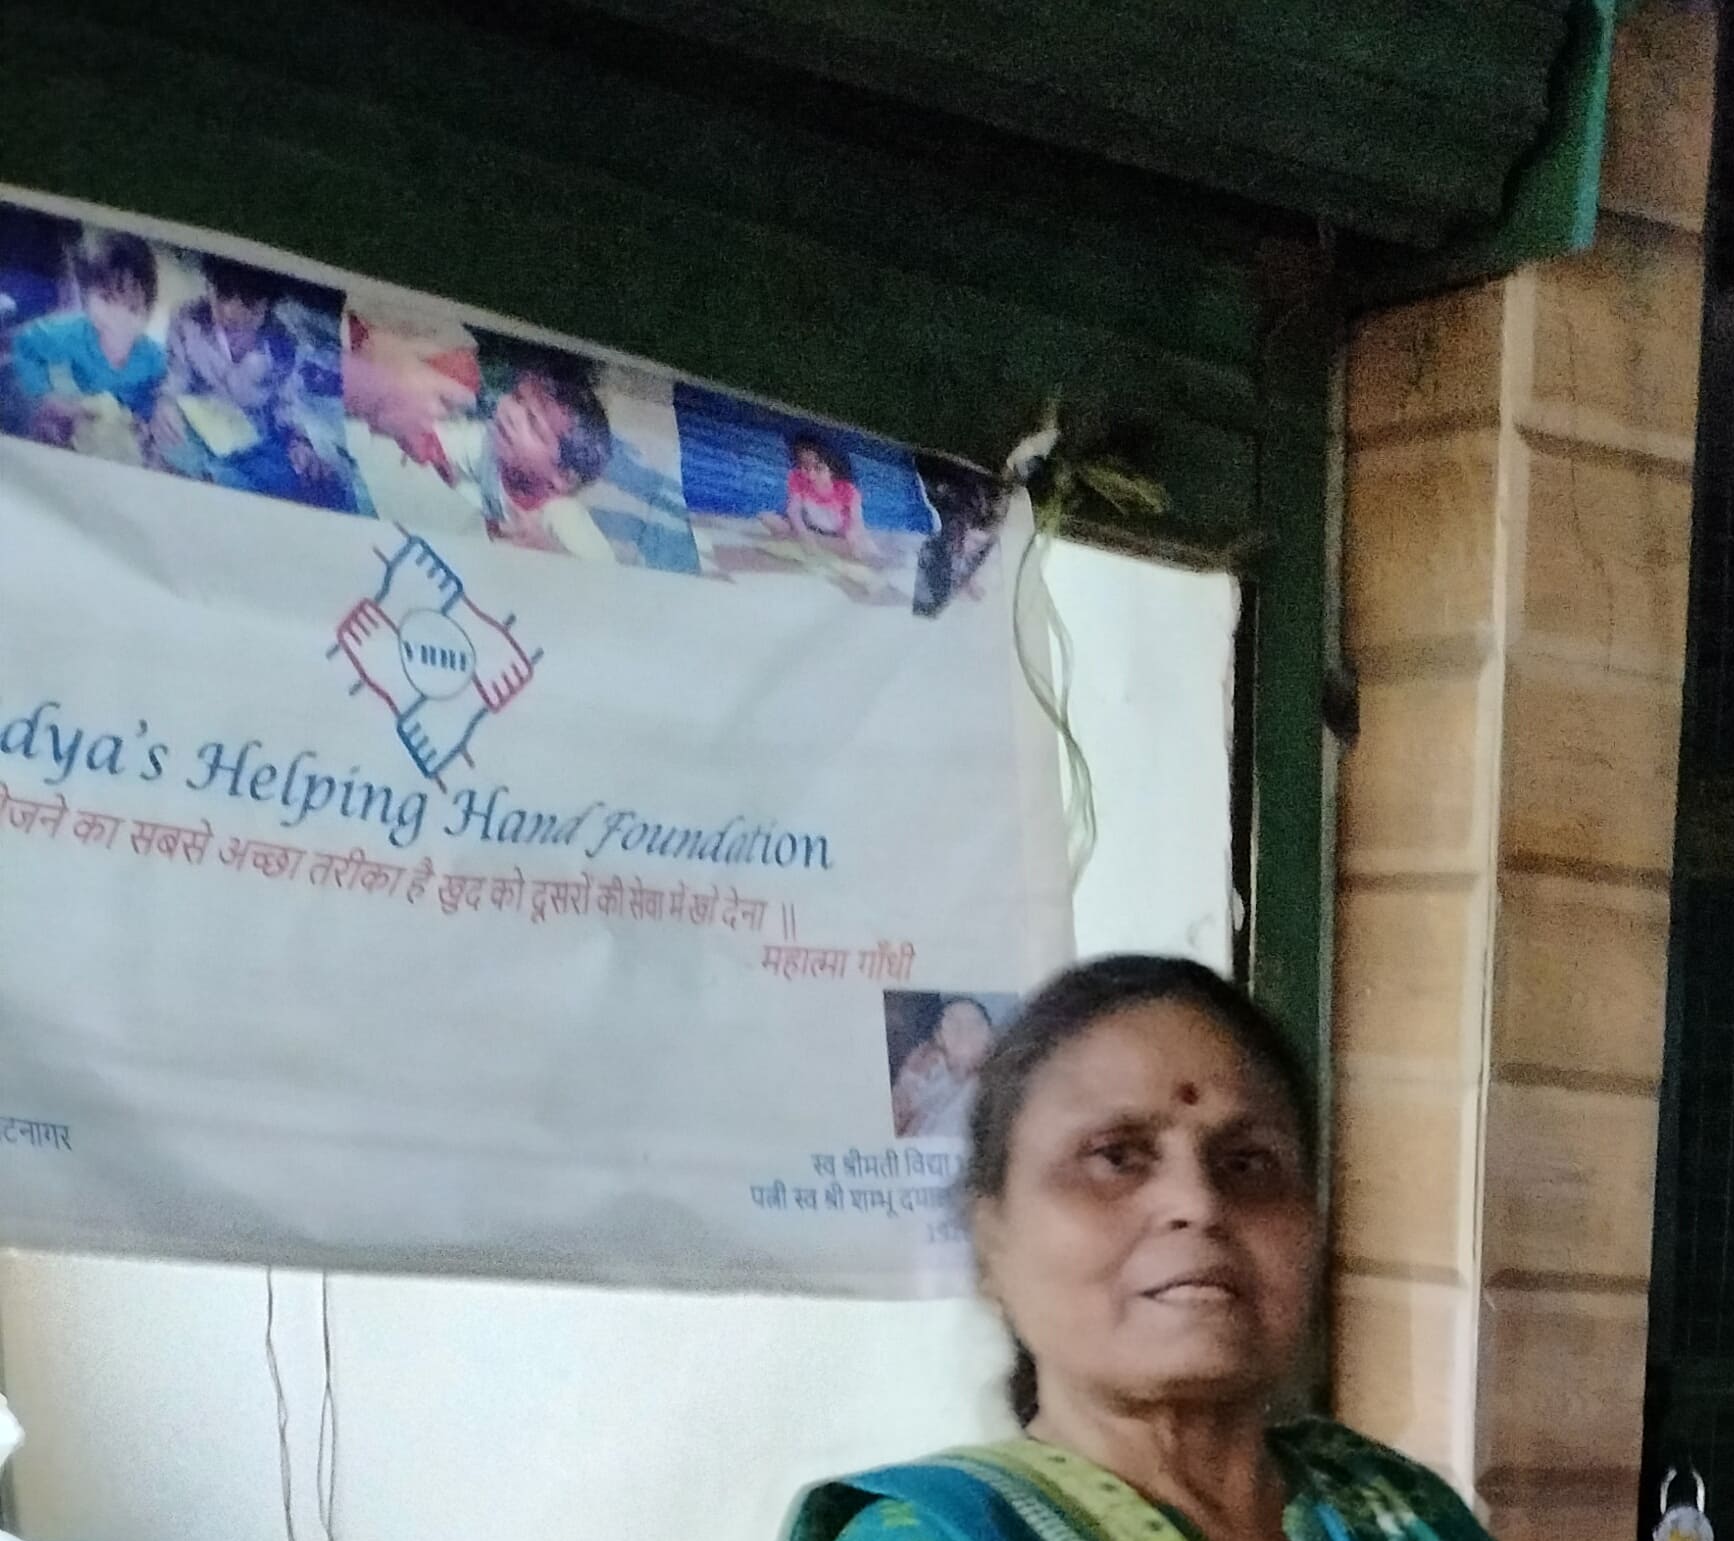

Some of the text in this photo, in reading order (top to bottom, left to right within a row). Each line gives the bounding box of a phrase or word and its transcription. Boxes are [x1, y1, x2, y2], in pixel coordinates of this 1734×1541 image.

[0, 700, 832, 869] dya's Helping Hand Foundation
[73, 810, 126, 848] का
[131, 819, 214, 863] सबसे
[219, 837, 308, 880] अच्छा
[309, 848, 407, 896] तरीका
[407, 856, 435, 904] है
[439, 874, 487, 914] खुद
[491, 864, 525, 911] को
[722, 886, 768, 931] देना
[762, 945, 849, 981] महात्मा
[0, 1116, 72, 1151] टनागर
